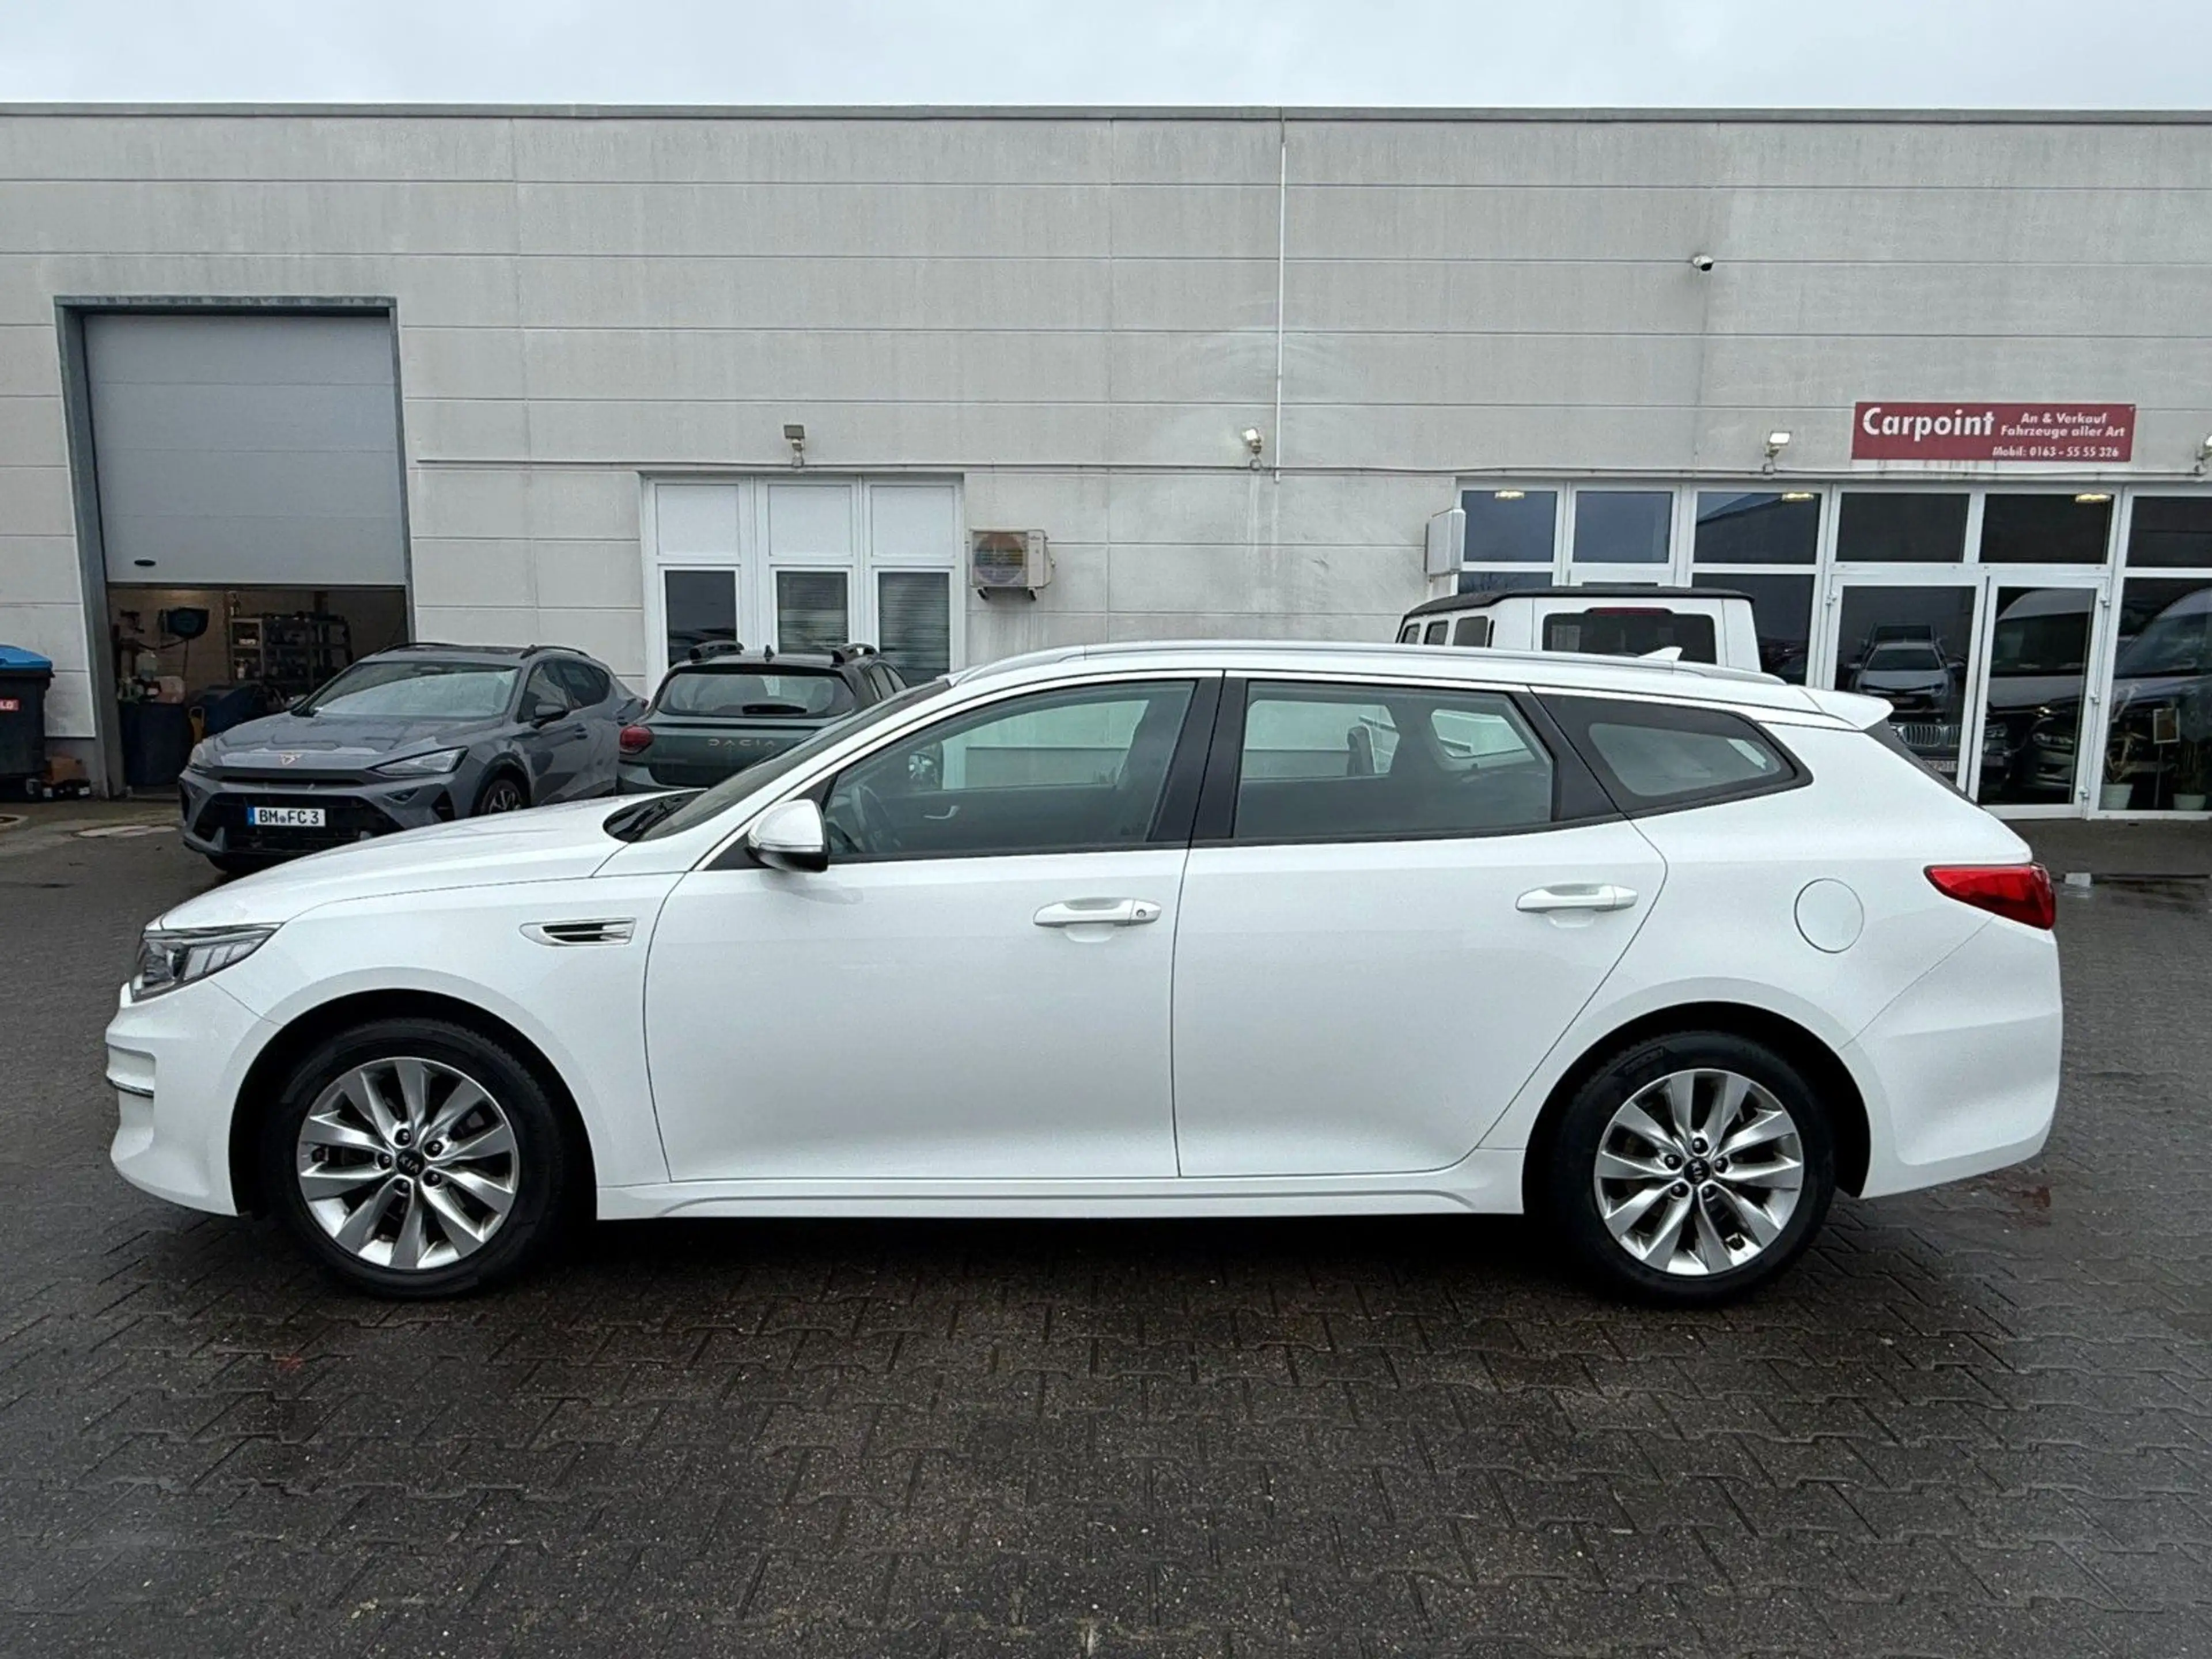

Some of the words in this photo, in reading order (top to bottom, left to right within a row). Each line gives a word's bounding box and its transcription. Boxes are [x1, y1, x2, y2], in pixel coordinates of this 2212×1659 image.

[1862, 407, 1995, 442] Carpoint
[2021, 412, 2038, 424] An
[2042, 412, 2052, 424] &
[2056, 412, 2107, 424] Verkauf
[2001, 425, 2067, 439] Fahrzeuge
[2071, 426, 2102, 437] aller
[2105, 426, 2126, 437] Art
[1992, 446, 2027, 457] Mobil:
[2029, 446, 2056, 457] 0163
[2099, 446, 2119, 457] 326
[707, 738, 775, 747] DACIA
[259, 809, 278, 823] BM
[287, 810, 307, 824] FC
[310, 810, 319, 824] 3
[399, 1154, 419, 1173] KIA
